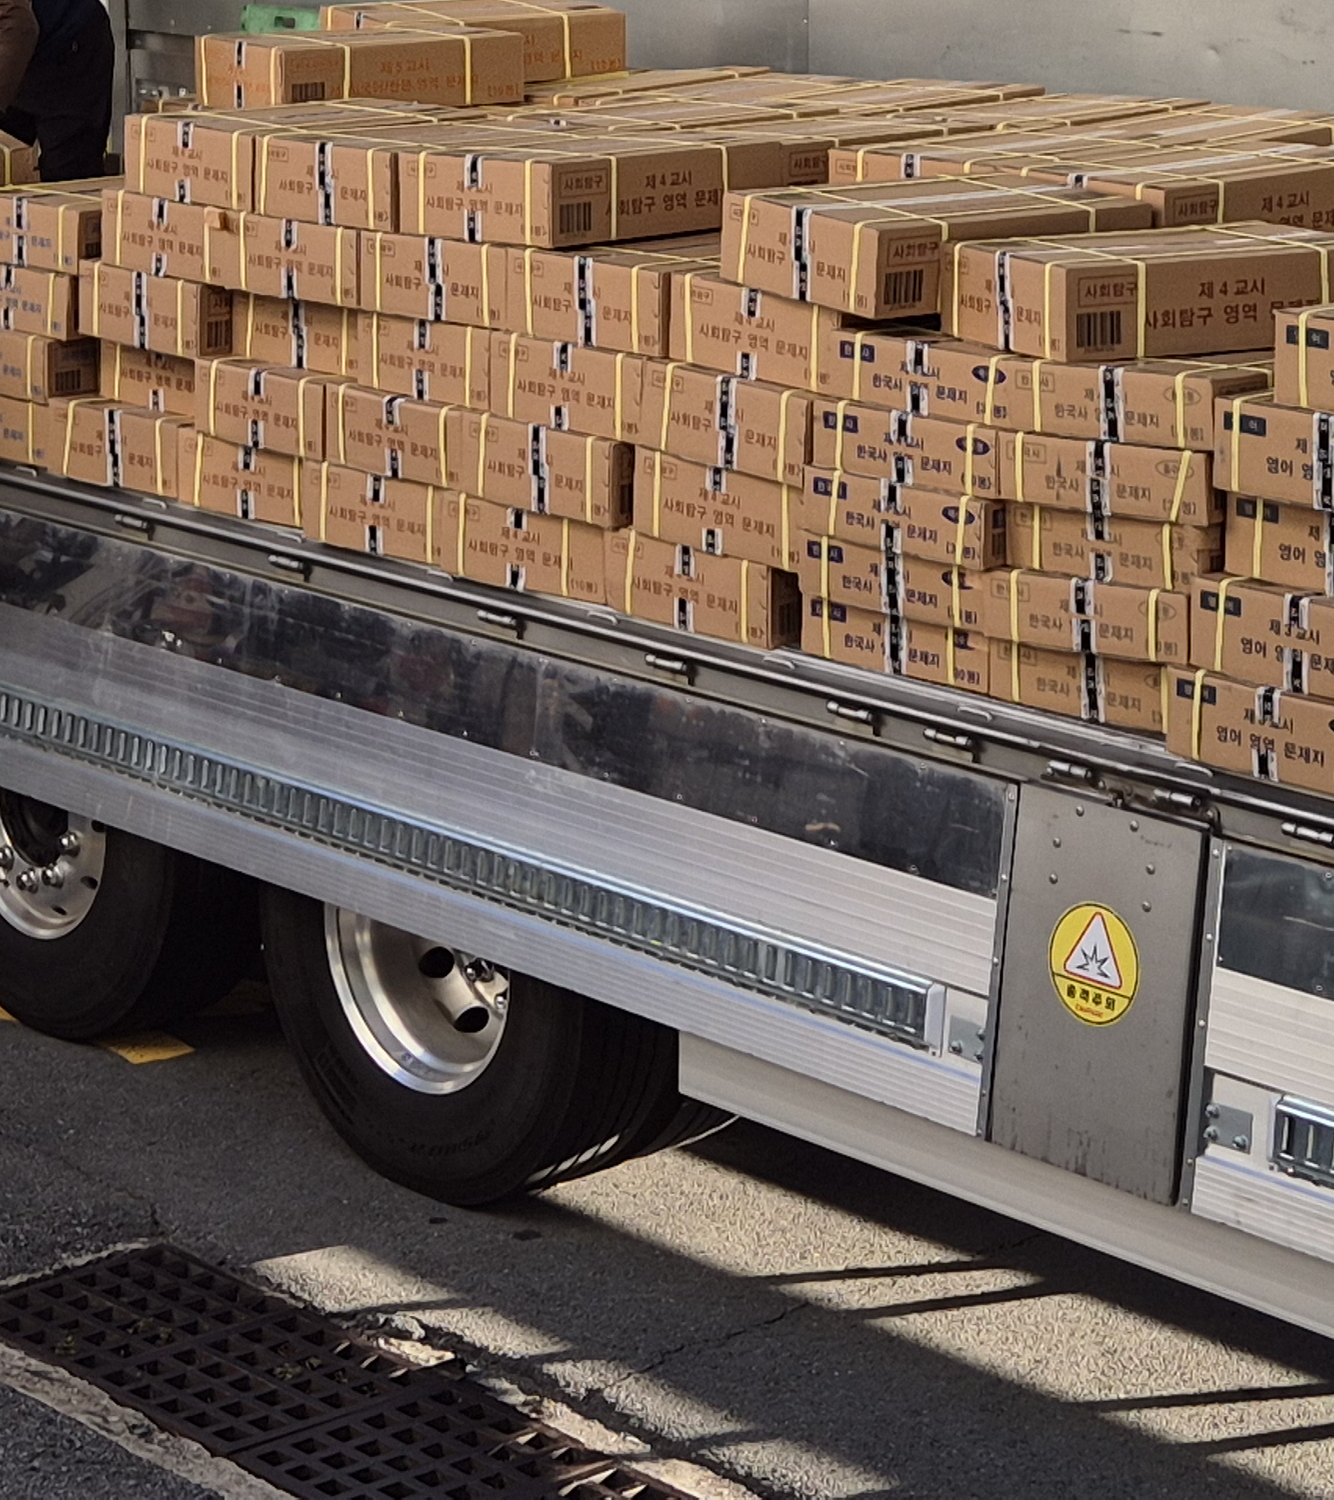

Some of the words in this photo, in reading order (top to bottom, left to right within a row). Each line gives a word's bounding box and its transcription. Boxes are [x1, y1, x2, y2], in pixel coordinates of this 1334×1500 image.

[645, 173, 657, 189] 제
[660, 174, 667, 186] 4
[670, 171, 692, 186] 교시
[663, 192, 687, 212] 영역
[1287, 191, 1310, 207] 교시
[1084, 281, 1137, 299] 사회탐구
[1199, 281, 1215, 299] 제
[1219, 281, 1229, 296] 4
[1234, 276, 1266, 297] 교시
[1223, 303, 1258, 325] 영역
[699, 323, 742, 345] 사회탐구
[776, 340, 808, 361] 문제지
[873, 373, 902, 392] 한국사
[936, 386, 967, 405] 문제지
[1055, 403, 1088, 421] 한국사
[1125, 411, 1159, 428] 문제지
[671, 411, 712, 432] 사회탐구
[745, 429, 777, 450] 문제지
[1296, 438, 1307, 454] 제
[857, 445, 887, 462] 한국사
[921, 457, 952, 475] 문제지
[1266, 456, 1293, 476] 영어
[664, 498, 707, 520] 사회탐구
[742, 516, 775, 538] 문제지
[846, 511, 875, 530] 한국사
[907, 524, 937, 543] 문제지
[1308, 525, 1320, 542] 제
[1279, 543, 1306, 564] 영어
[906, 589, 937, 607] 문제지
[1269, 620, 1280, 635] 제
[1295, 626, 1320, 645] 교시
[908, 649, 940, 668] 문제지
[1241, 638, 1267, 658] 영어
[1217, 725, 1242, 746] 영어
[1283, 742, 1325, 767] 문제지
